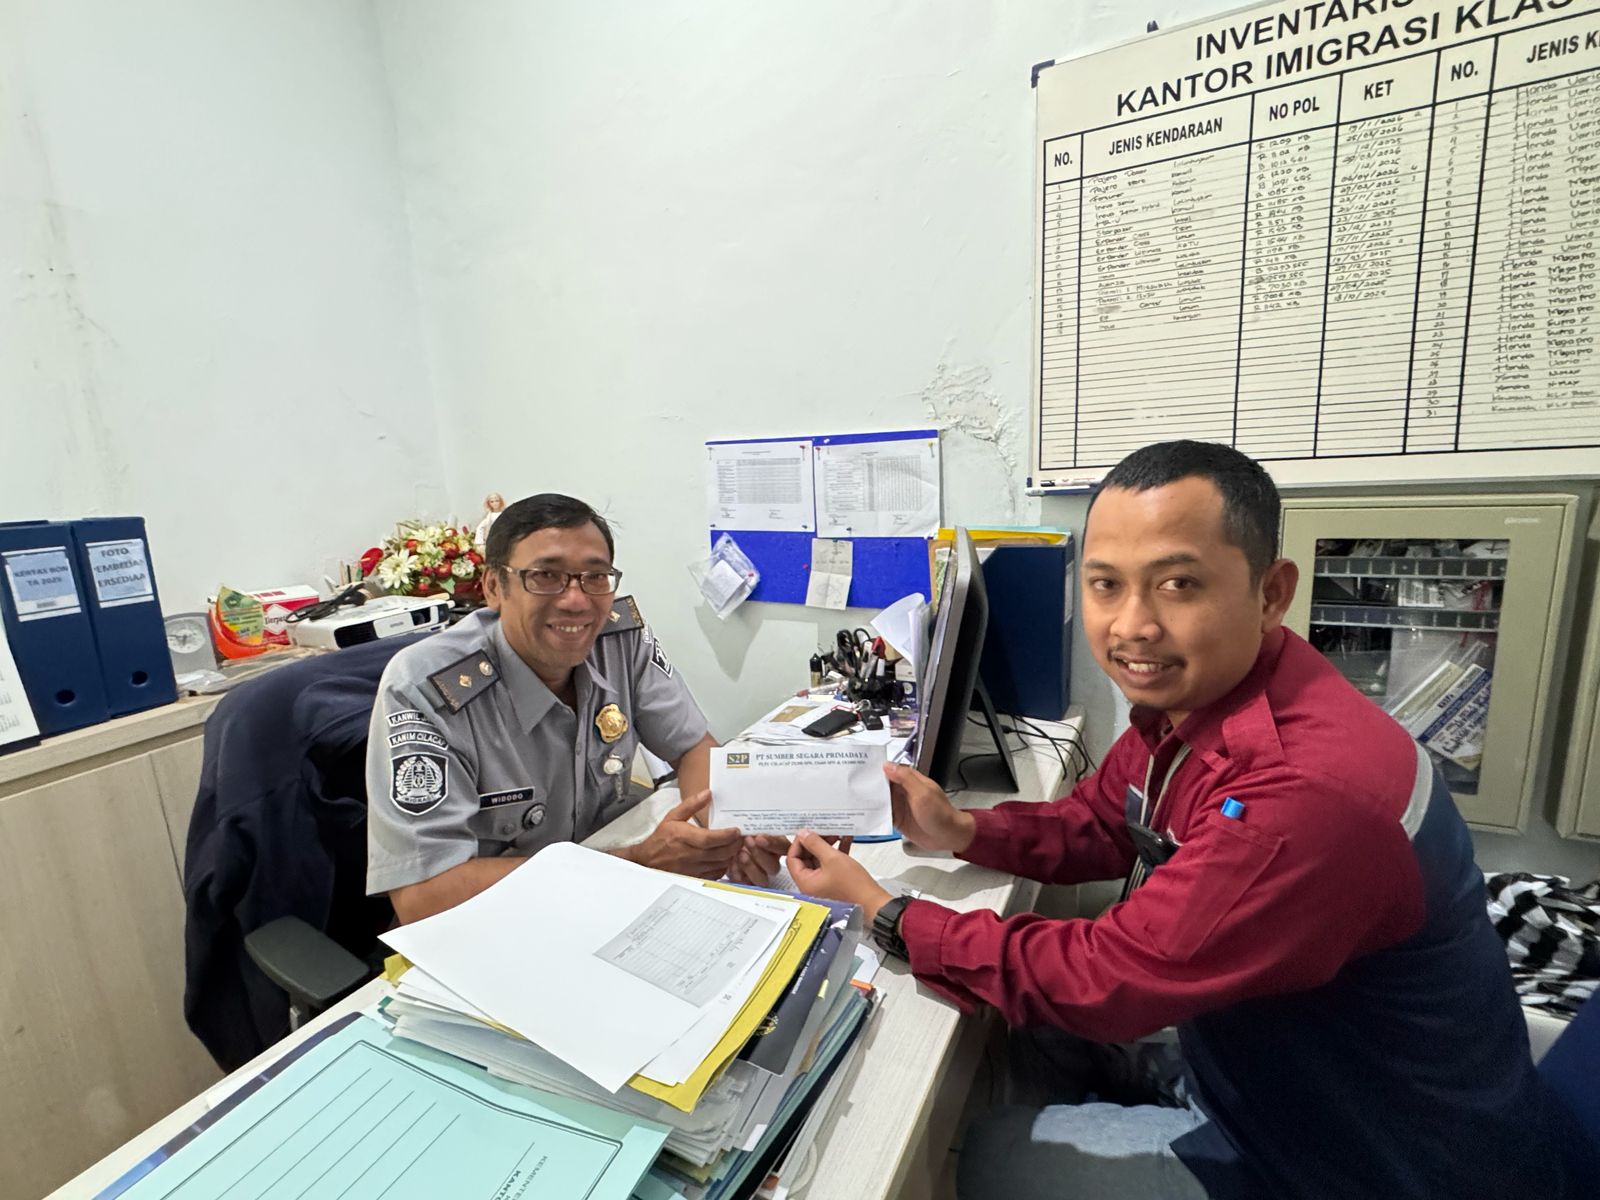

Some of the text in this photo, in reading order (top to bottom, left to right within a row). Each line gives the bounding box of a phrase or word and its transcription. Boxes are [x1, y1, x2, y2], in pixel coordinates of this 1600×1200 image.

[1526, 36, 1579, 63] JENIS
[1117, 59, 1253, 117] KANTOR
[1266, 12, 1440, 80] IMIGRASI
[1451, 60, 1478, 82] NO.
[1364, 79, 1394, 100] KET
[1269, 96, 1320, 122] NO POL
[1108, 116, 1223, 157] JENIS KENDARAAN
[1054, 152, 1073, 167] NO.
[101, 547, 129, 558] FOTO
[391, 711, 420, 724] KANWIL
[392, 733, 416, 745] KANIM
[766, 752, 795, 760] SUMBER
[796, 752, 825, 760] SEGARA
[826, 751, 869, 760] PRIMADAYA
[490, 793, 524, 804] WIDODO
